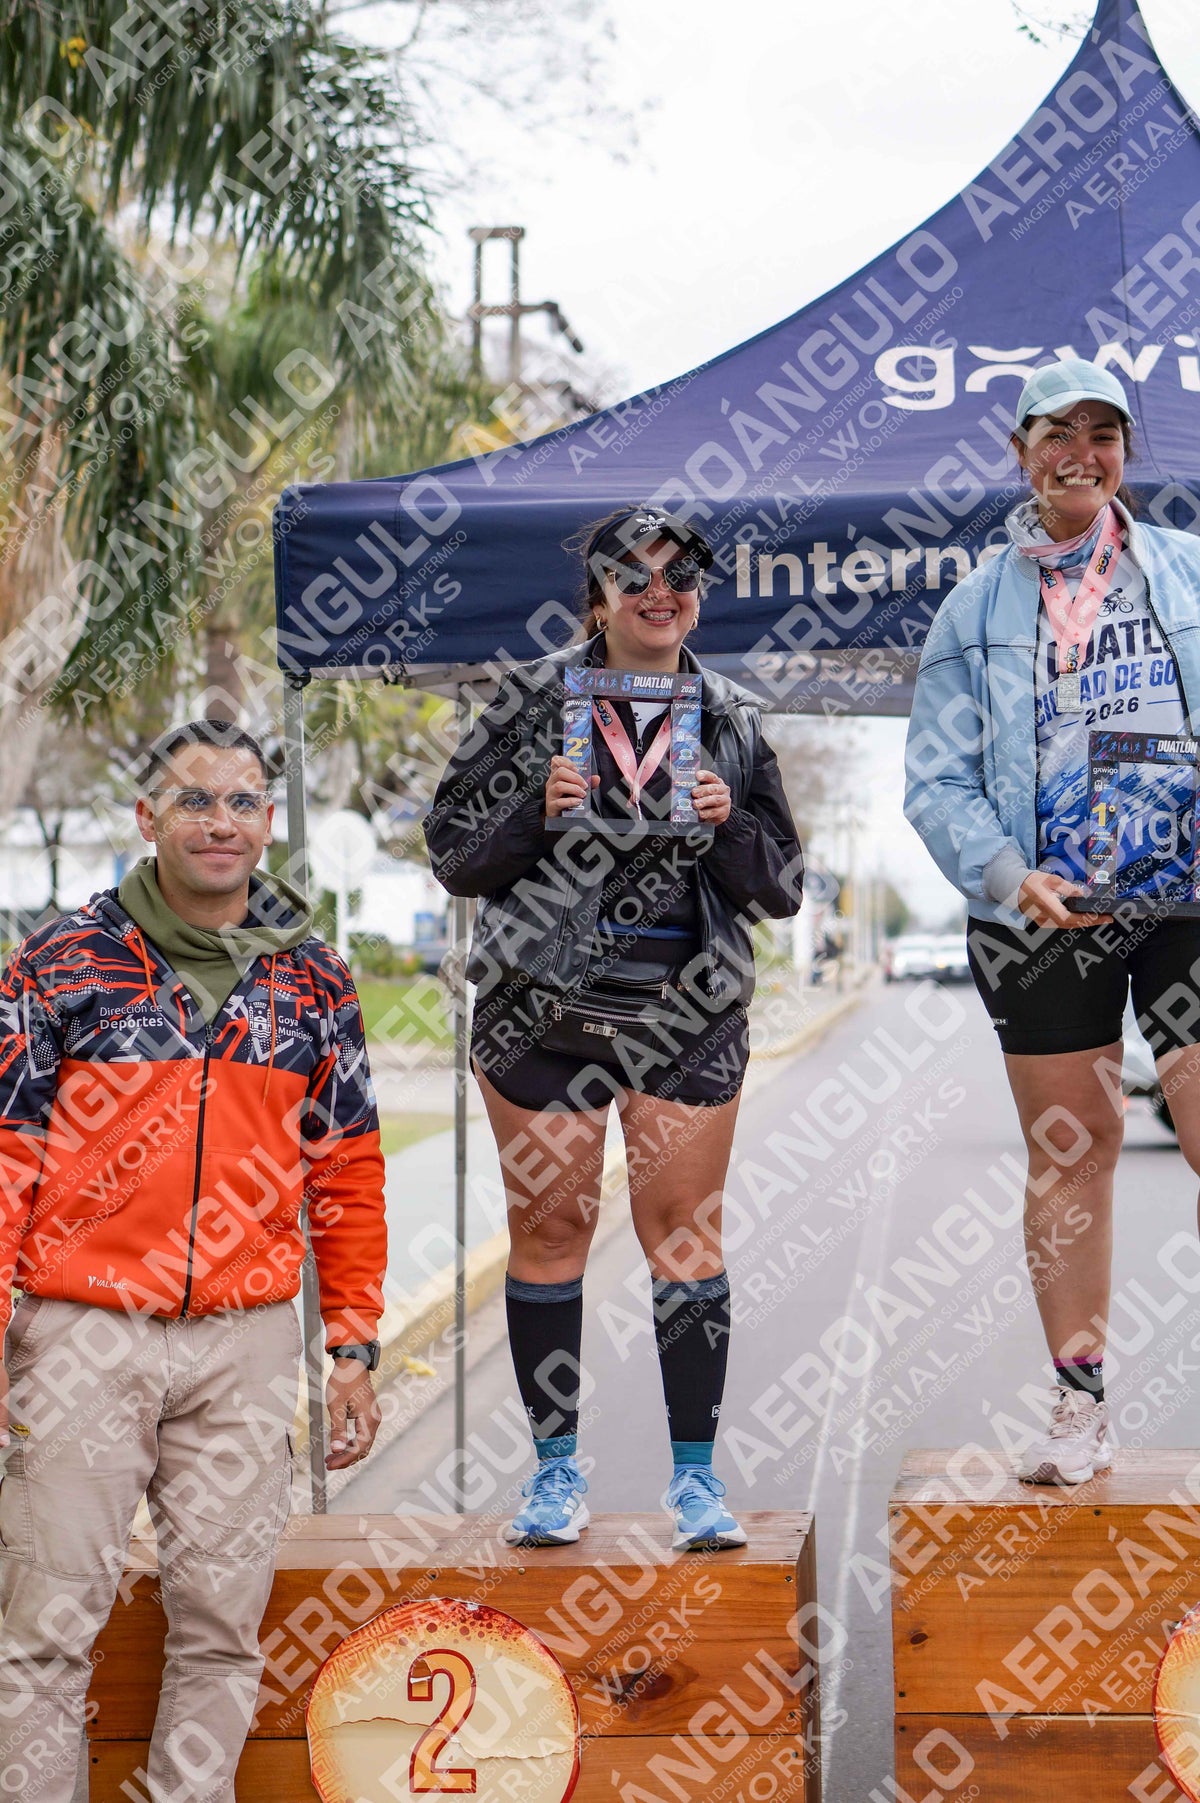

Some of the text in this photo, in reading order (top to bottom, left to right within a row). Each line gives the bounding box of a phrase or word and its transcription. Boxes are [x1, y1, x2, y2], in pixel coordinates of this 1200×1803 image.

[622, 674, 674, 691] 5 DUATLÓN
[680, 685, 696, 693] 2026
[1035, 669, 1107, 728] CIUAD
[1115, 662, 1143, 693] DE
[1085, 696, 1140, 726] 2026
[1146, 738, 1198, 758] 5 DUATLÓN
[100, 1004, 147, 1016] Dirección
[100, 1016, 164, 1031] Deportes
[278, 1016, 298, 1026] Goya
[408, 1648, 476, 1793] 2
